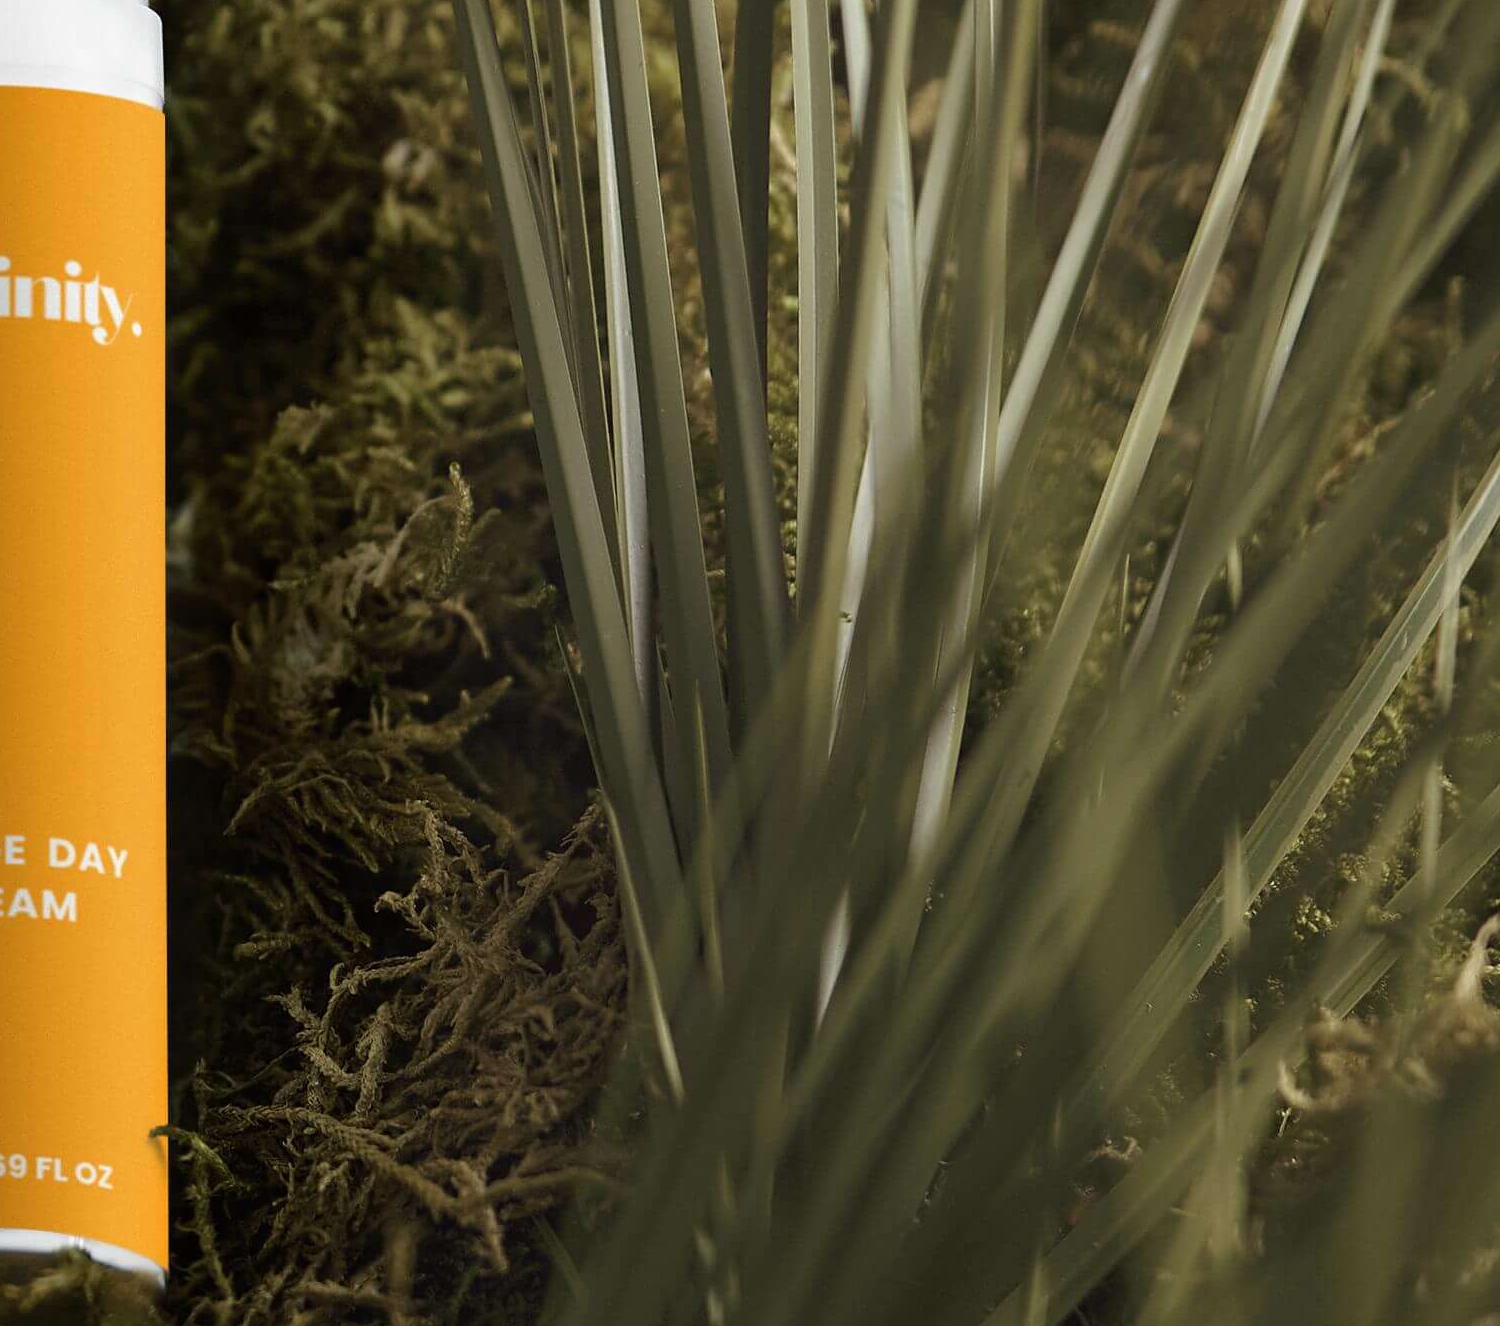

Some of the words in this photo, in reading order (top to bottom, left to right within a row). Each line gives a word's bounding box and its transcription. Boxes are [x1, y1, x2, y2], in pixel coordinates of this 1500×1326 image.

[48, 837, 128, 879] DAY
[35, 1156, 69, 1182] FL
[74, 1161, 114, 1189] OZ
